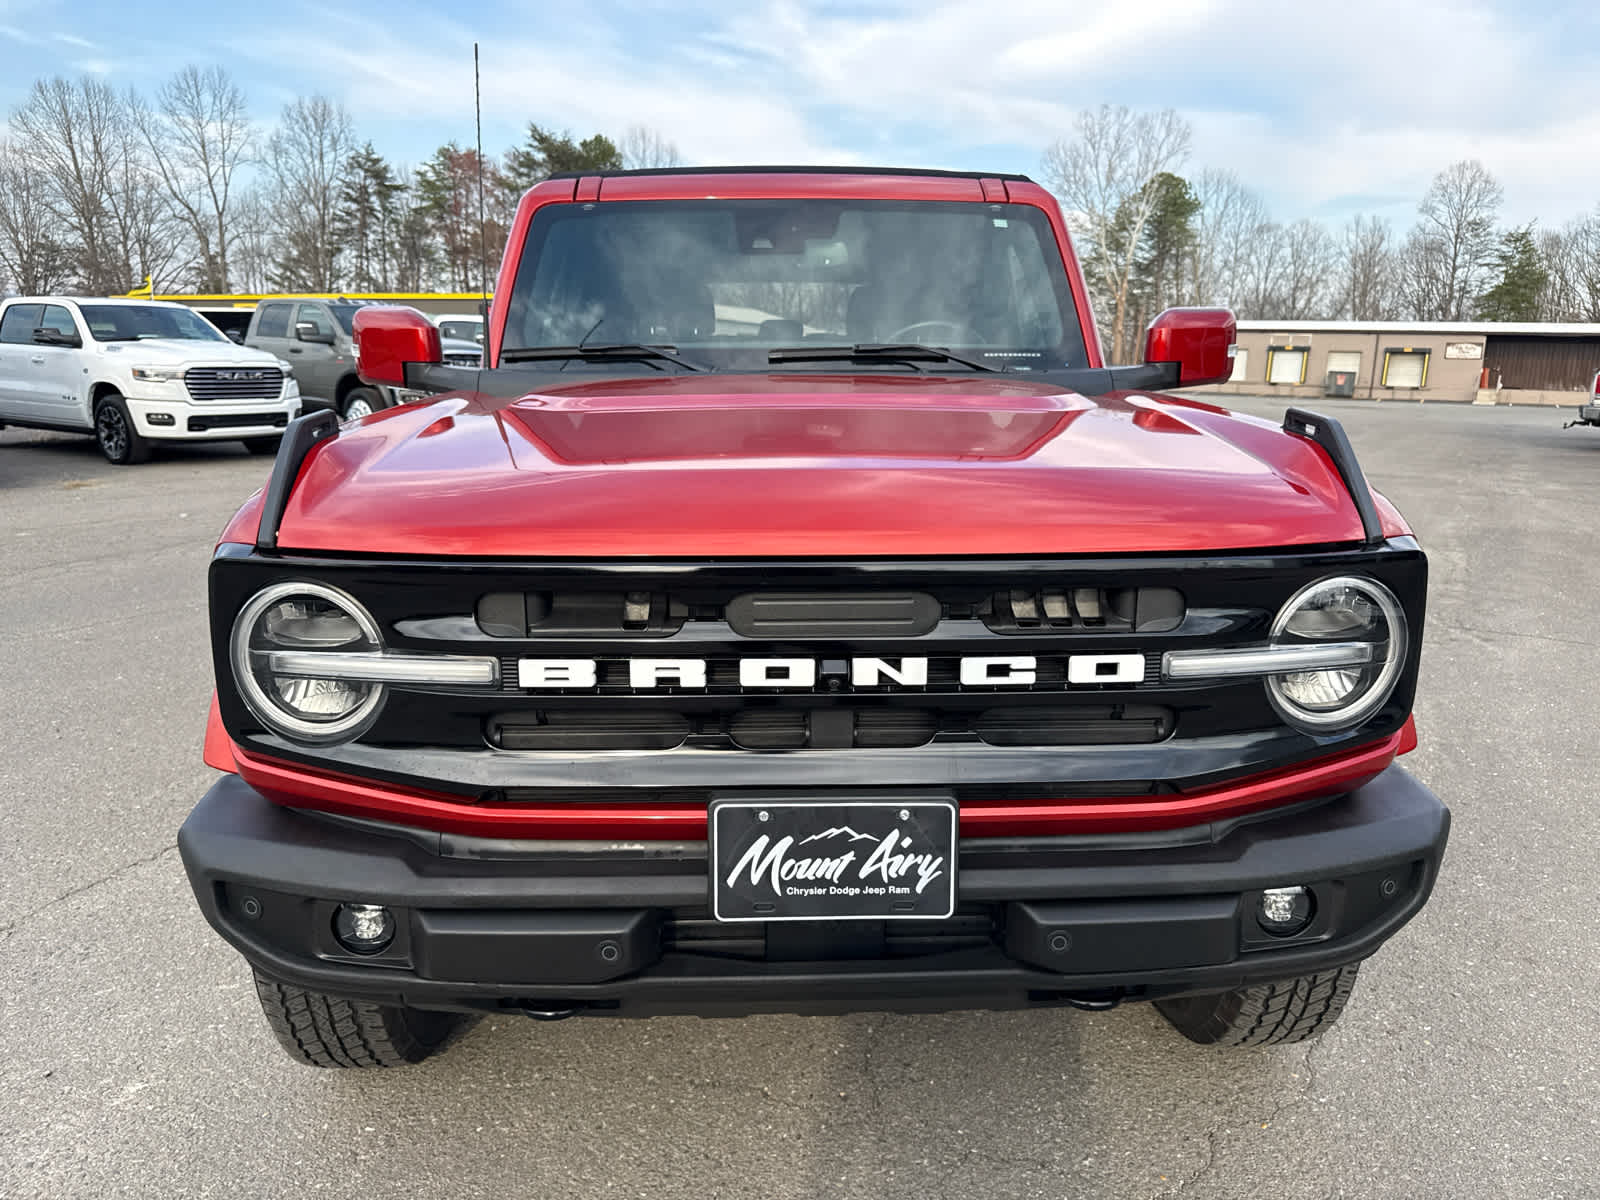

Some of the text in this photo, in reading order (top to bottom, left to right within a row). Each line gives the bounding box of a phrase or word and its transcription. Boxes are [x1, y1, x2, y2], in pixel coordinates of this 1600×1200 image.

[518, 654, 1146, 688] BRONCO
[726, 828, 943, 896] Mount Airy
[786, 886, 910, 896] Chrysler Dodge Jeep Ram
